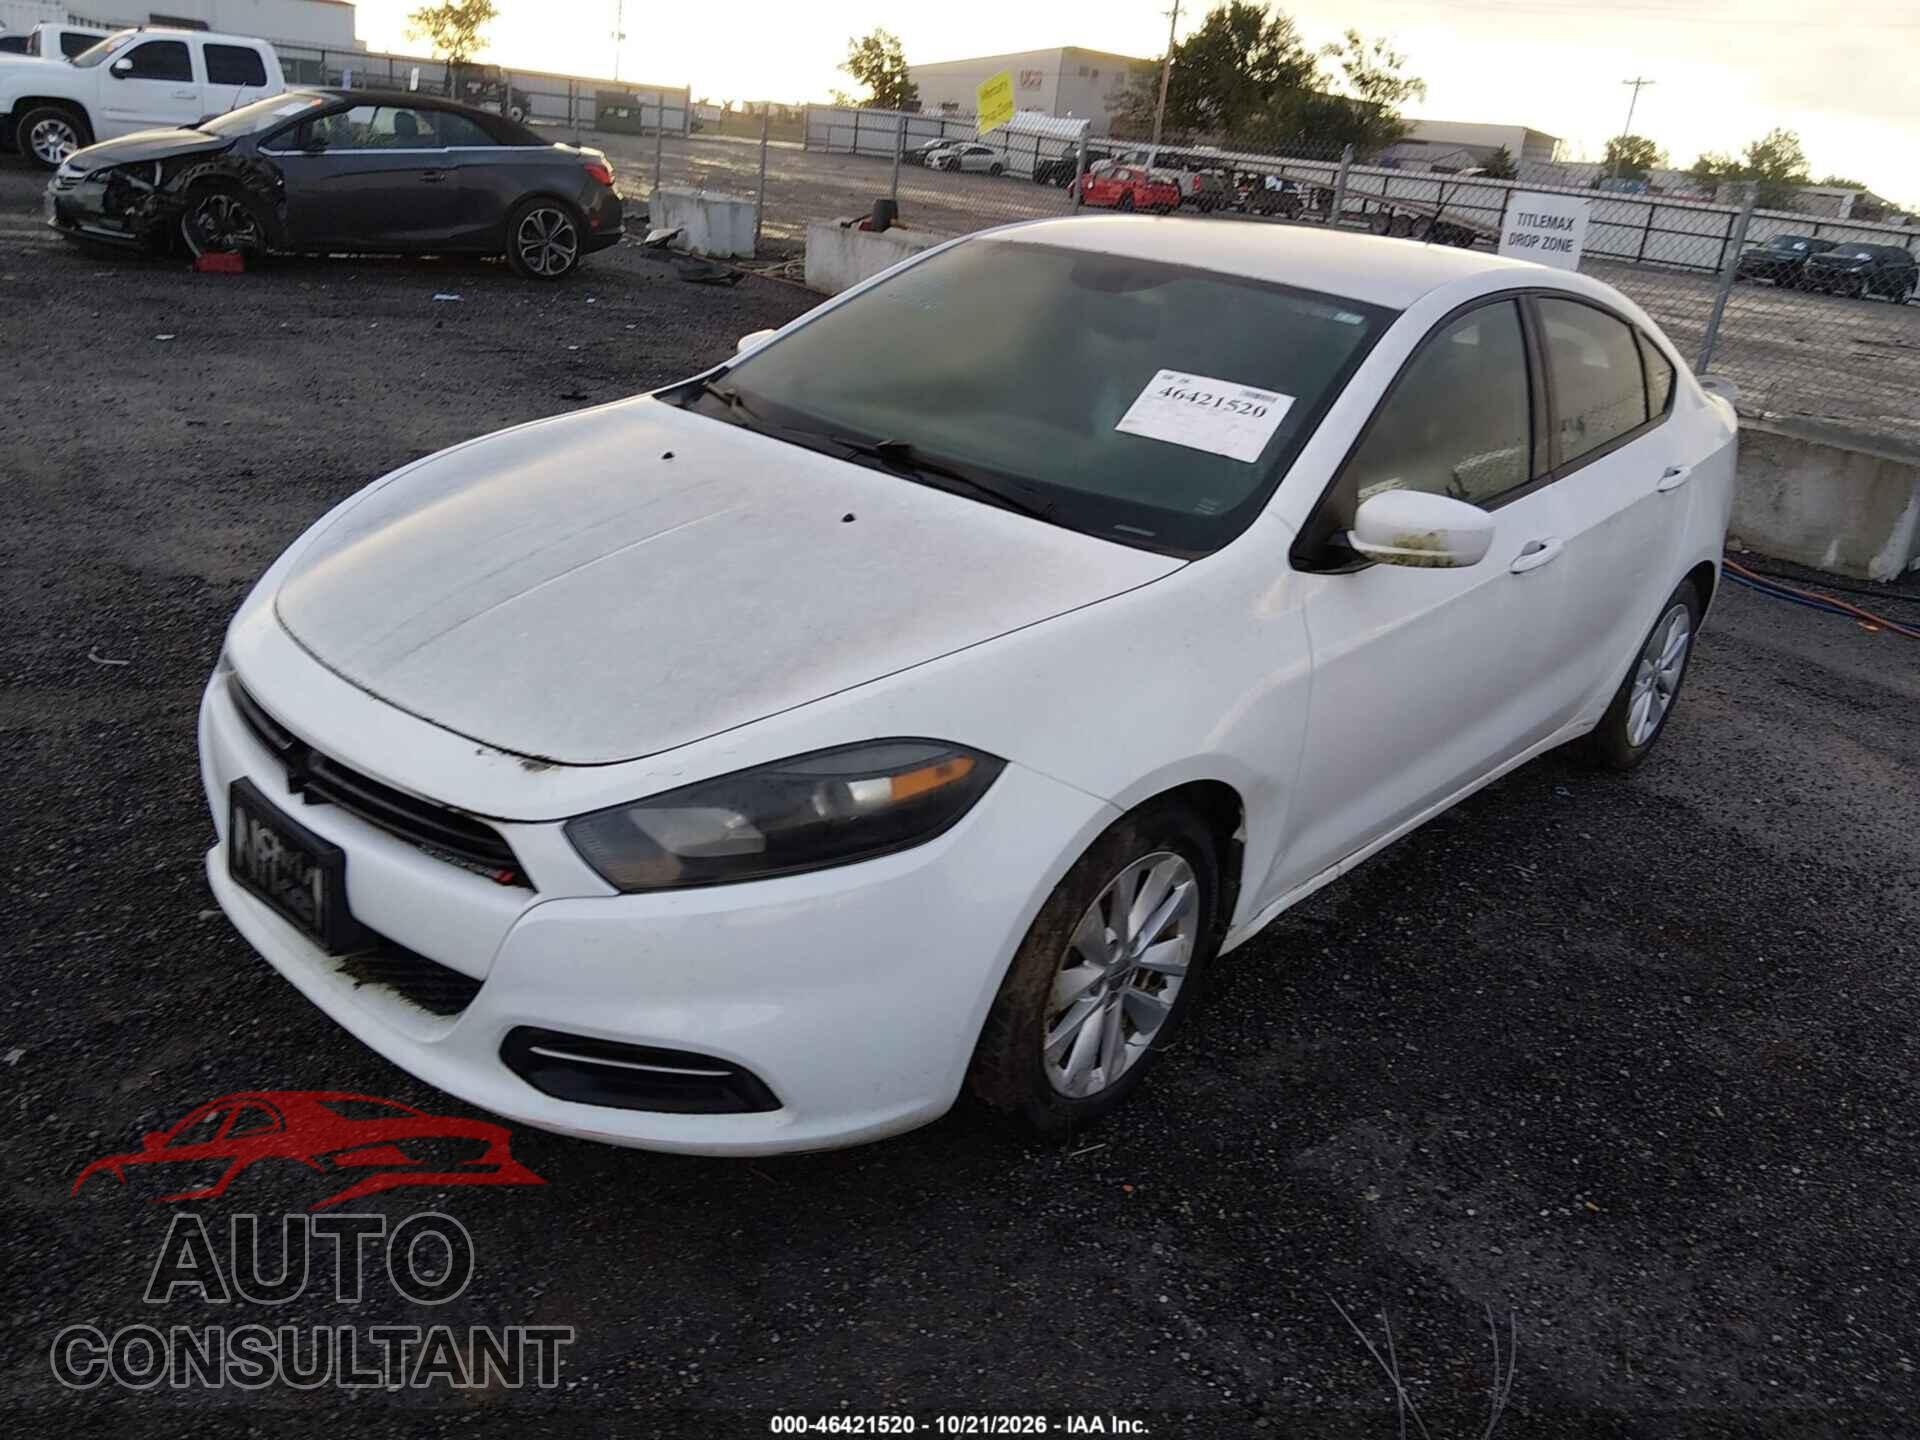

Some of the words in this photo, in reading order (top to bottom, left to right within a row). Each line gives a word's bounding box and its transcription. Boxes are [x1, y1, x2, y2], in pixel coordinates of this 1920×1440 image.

[1518, 213, 1576, 232] TITLEMAX
[1508, 232, 1540, 248] DROP
[1541, 236, 1574, 253] ZONE
[1157, 385, 1268, 419] 46421520
